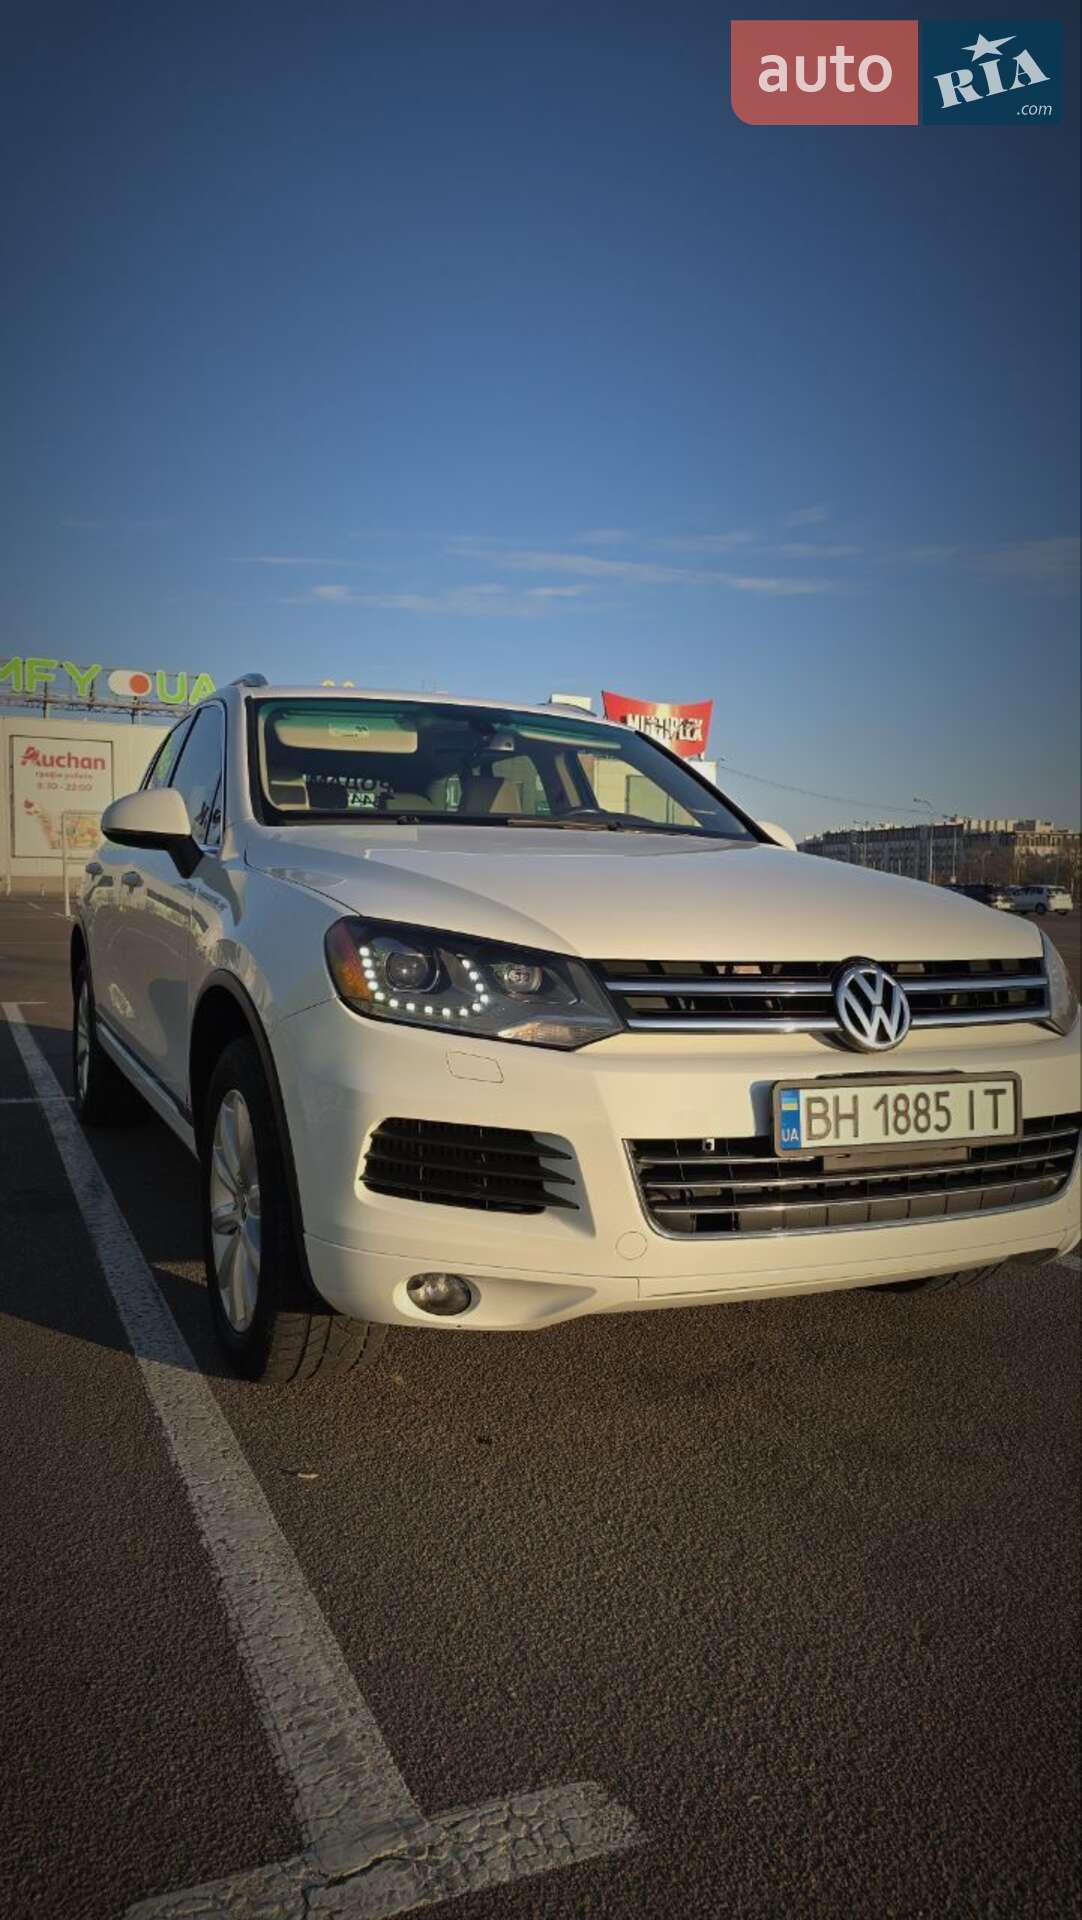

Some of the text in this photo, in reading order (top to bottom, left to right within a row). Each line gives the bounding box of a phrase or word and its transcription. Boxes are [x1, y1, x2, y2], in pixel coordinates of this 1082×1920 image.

[156, 671, 216, 706] UA
[20, 746, 106, 770] Auchan
[806, 1088, 1007, 1140] BH 1885 IT
[782, 1127, 799, 1142] UA
